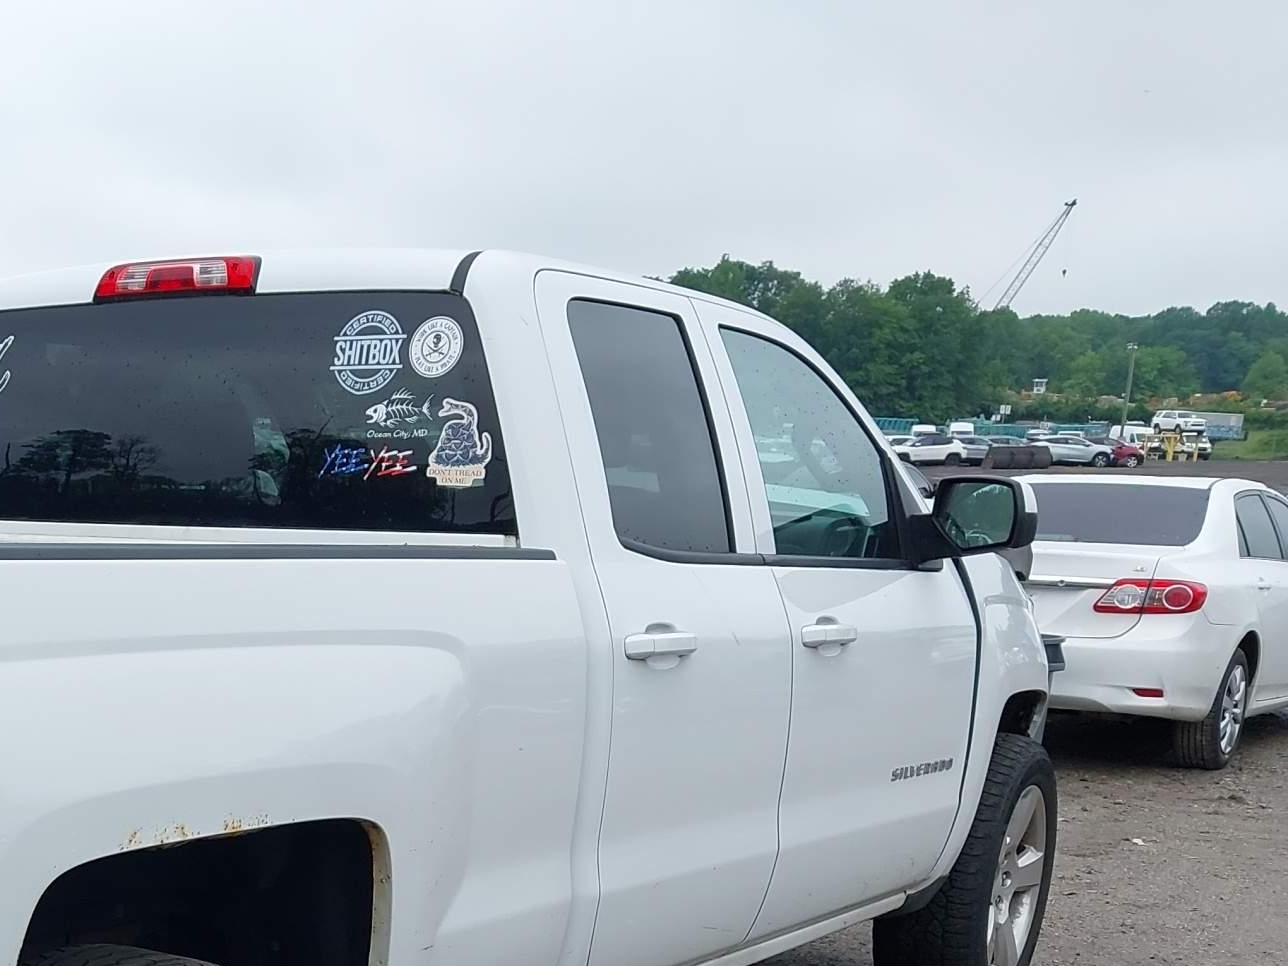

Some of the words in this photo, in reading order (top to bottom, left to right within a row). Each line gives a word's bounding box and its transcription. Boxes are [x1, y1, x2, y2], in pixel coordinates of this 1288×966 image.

[346, 314, 396, 335] CERTIFIED
[334, 339, 403, 366] SHITBOX
[340, 369, 391, 390] CERTIFIED
[366, 429, 392, 438] Ocean
[411, 428, 428, 438] MD
[363, 445, 417, 480] YEE
[890, 758, 954, 782] SILVERADO
